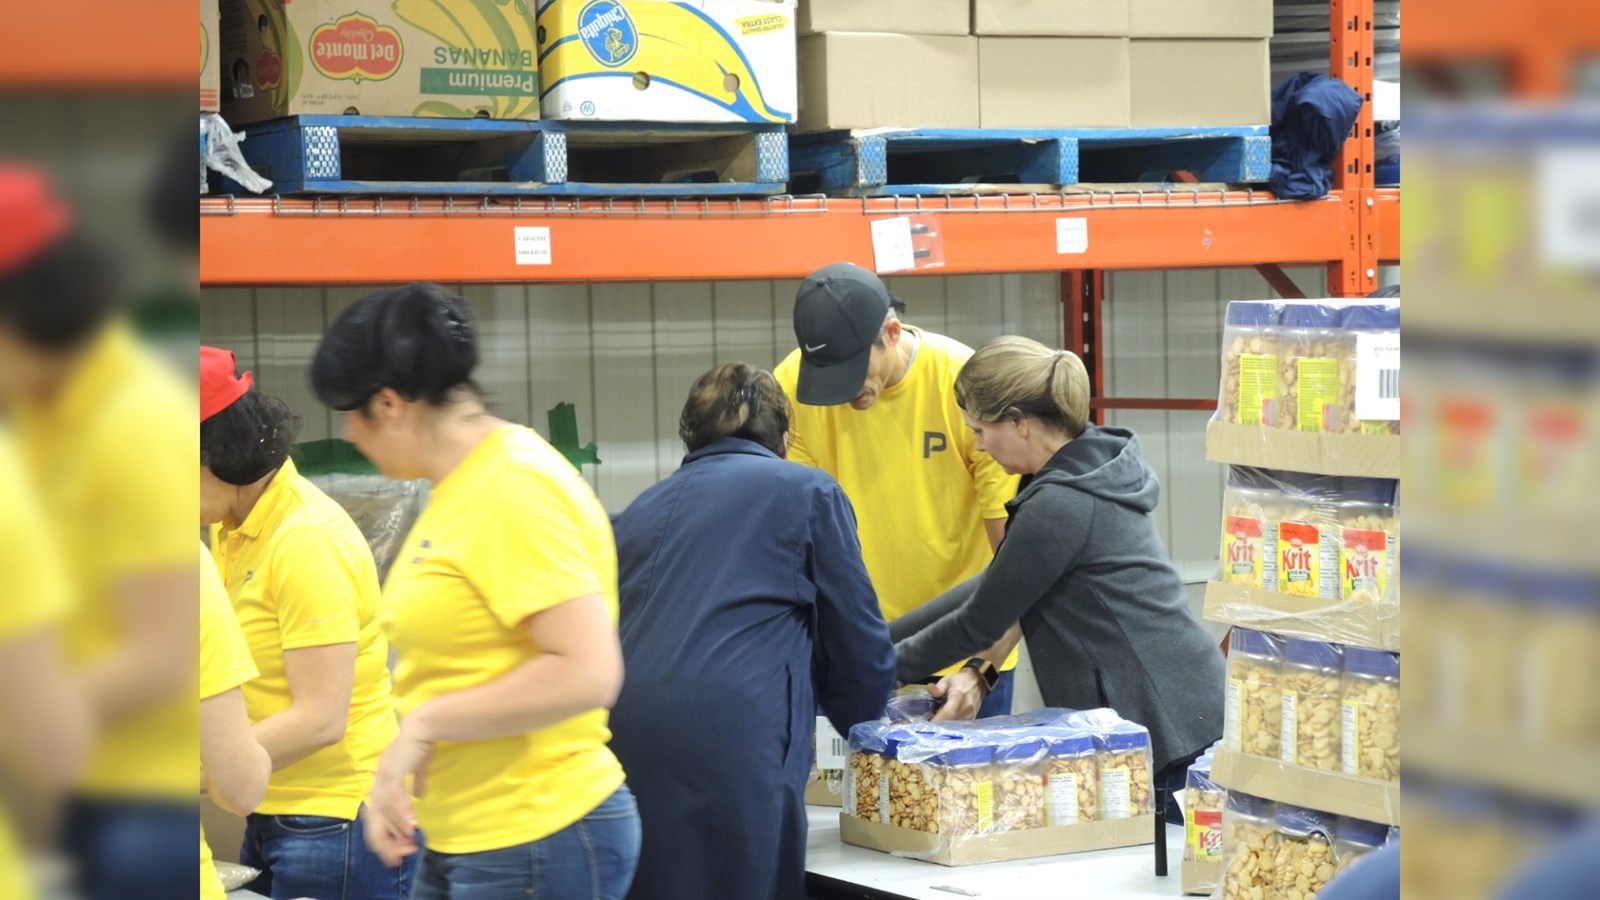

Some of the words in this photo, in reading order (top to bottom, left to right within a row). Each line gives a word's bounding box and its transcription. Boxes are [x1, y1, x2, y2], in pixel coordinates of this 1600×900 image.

[580, 5, 626, 41] Chiquita
[741, 19, 763, 28] EXTRA
[763, 15, 782, 25] CLASS
[316, 42, 367, 60] Monte
[370, 43, 395, 61] Del
[434, 46, 532, 67] BANANAS
[449, 72, 534, 93] Premium
[923, 431, 947, 459] P
[1227, 541, 1256, 564] Krit
[1282, 547, 1312, 572] Krit
[1345, 553, 1379, 580] Krit
